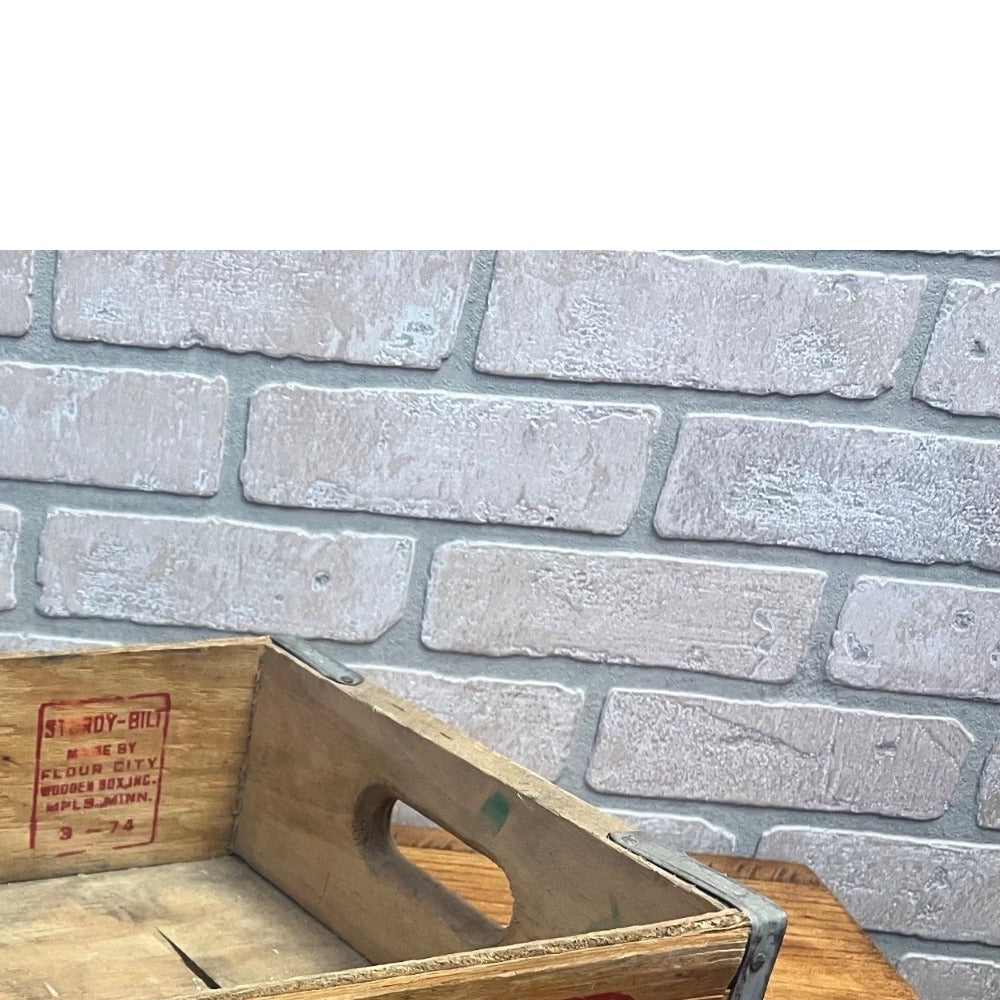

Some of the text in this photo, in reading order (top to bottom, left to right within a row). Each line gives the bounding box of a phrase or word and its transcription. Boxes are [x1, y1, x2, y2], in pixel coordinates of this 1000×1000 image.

[117, 741, 137, 755] BY
[41, 757, 158, 781] FLOUR CITY
[40, 780, 94, 797] WOODEN
